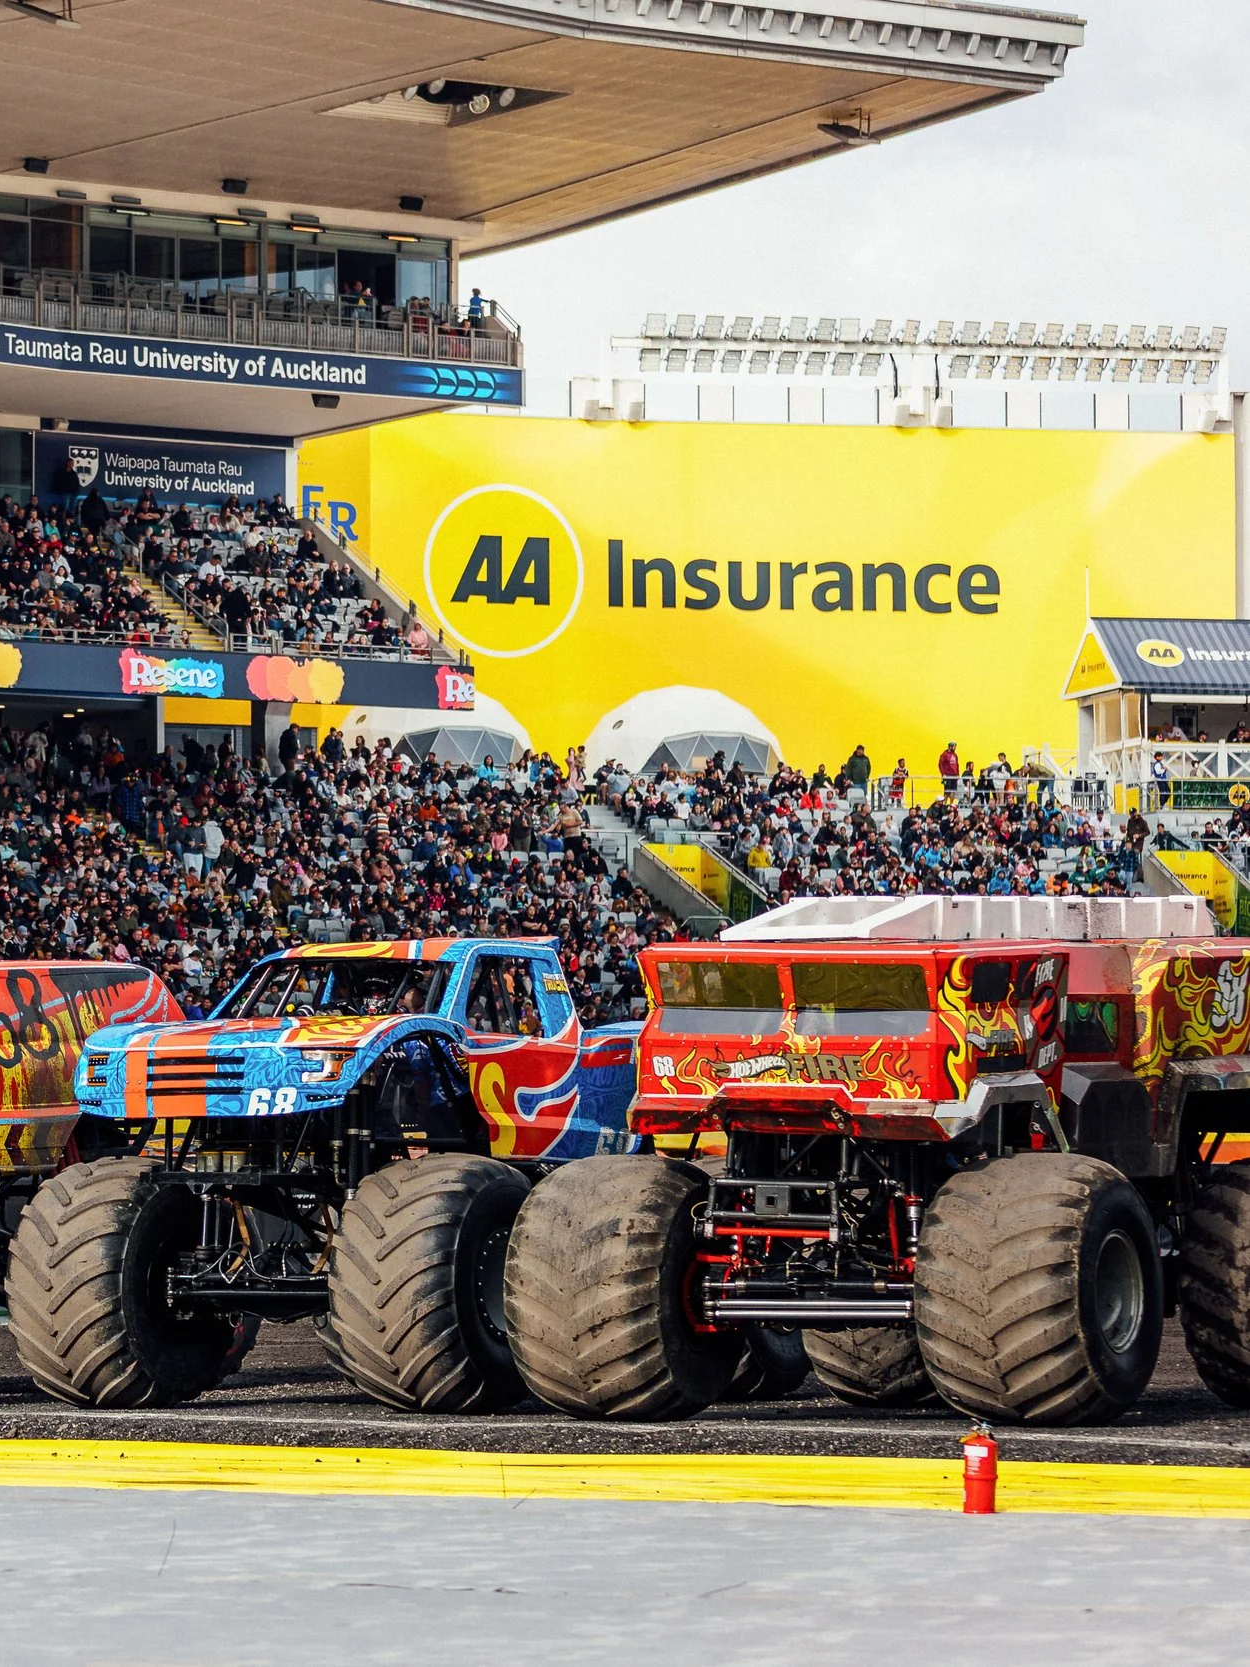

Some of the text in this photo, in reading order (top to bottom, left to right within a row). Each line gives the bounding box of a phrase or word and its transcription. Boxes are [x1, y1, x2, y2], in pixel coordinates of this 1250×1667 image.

[4, 333, 82, 362] Taumata
[90, 343, 127, 365] Rau
[133, 346, 240, 379] University
[244, 355, 267, 376] of
[270, 357, 367, 385] Auckland
[105, 452, 242, 477] Waipapa Taumata Rau
[104, 471, 255, 496] University of Auckland
[452, 535, 1000, 614] AA Insurance
[1148, 648, 1176, 658] AA
[129, 658, 218, 689] Resene
[653, 1056, 676, 1077] 68
[729, 1061, 751, 1078] HOT
[783, 1053, 863, 1081] FIRE
[246, 1087, 298, 1116] 68
